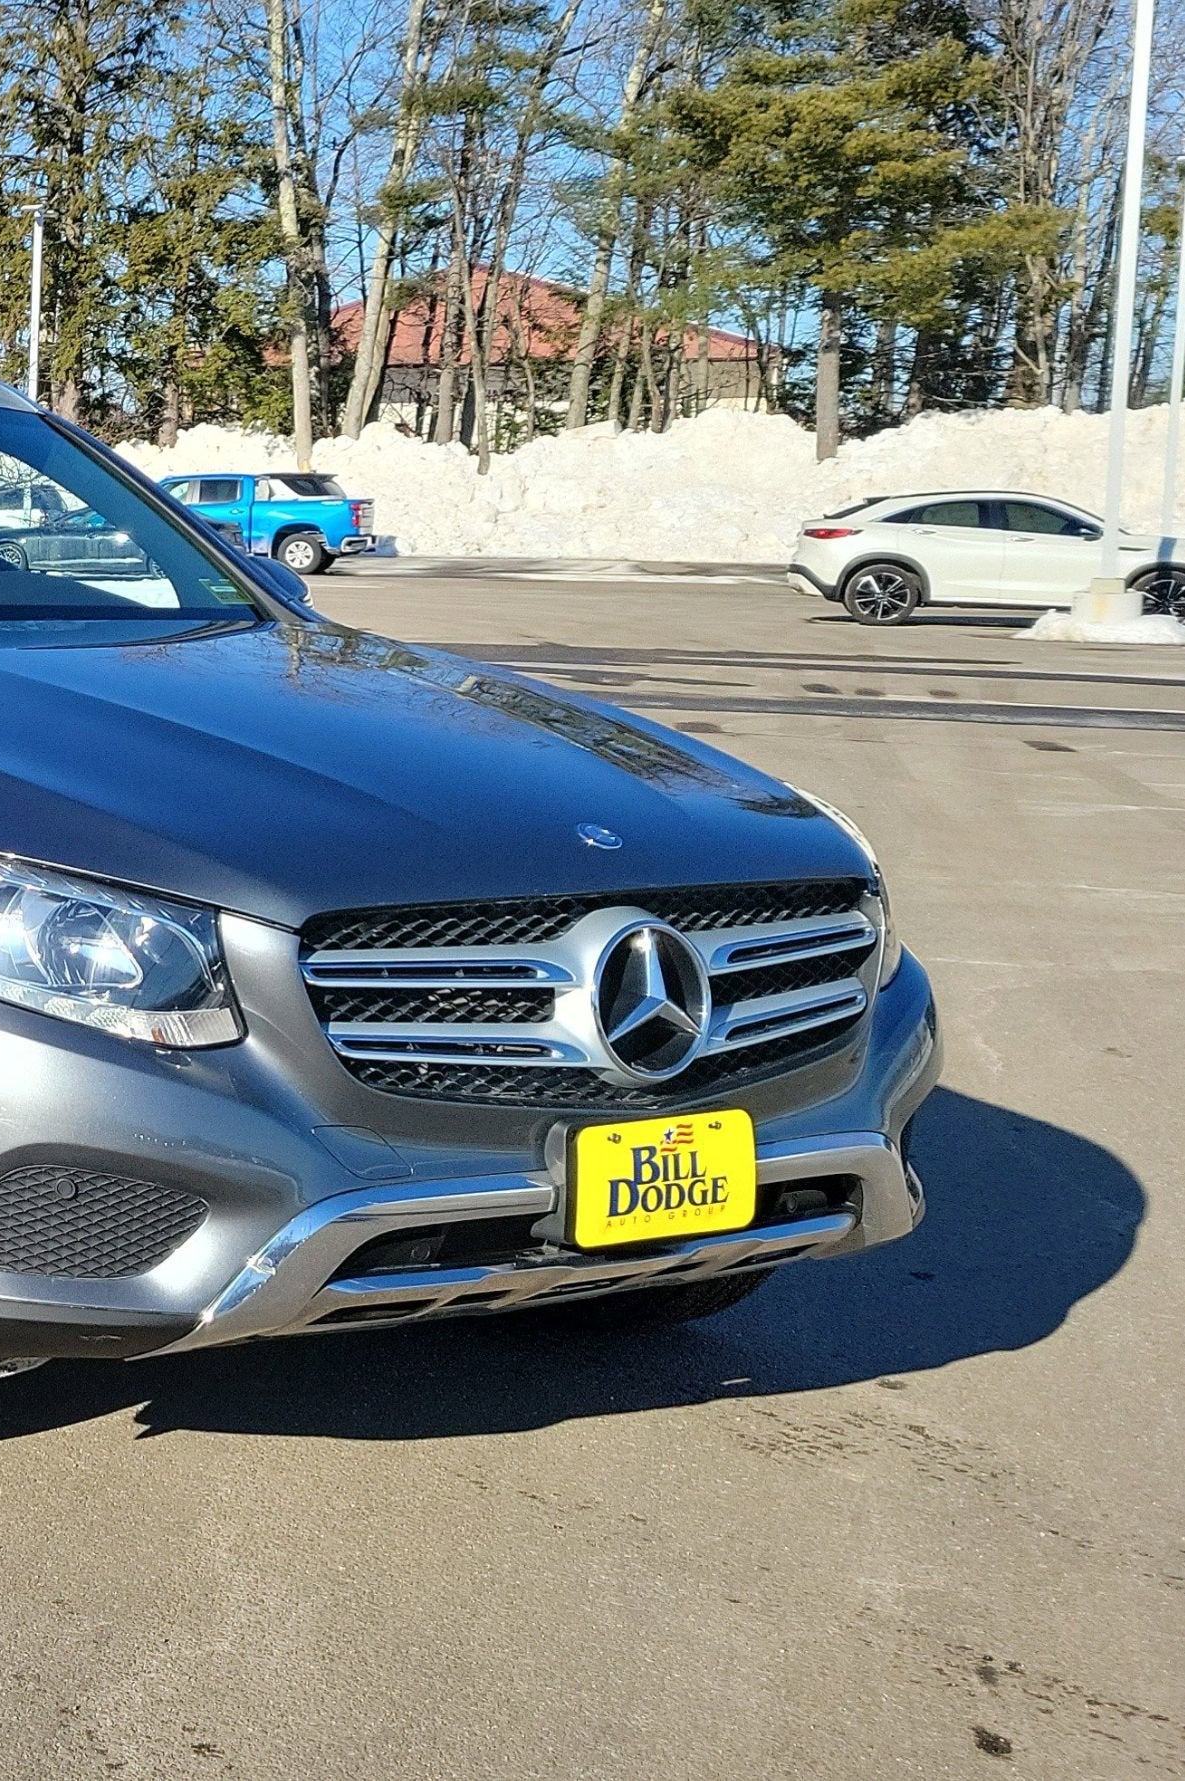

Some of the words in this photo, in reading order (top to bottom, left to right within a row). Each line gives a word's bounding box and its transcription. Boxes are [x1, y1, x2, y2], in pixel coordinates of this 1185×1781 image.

[629, 1145, 707, 1185] BILL
[605, 1214, 652, 1228] AUTO
[667, 1204, 726, 1221] GROUP
[606, 1176, 730, 1218] DODGE
